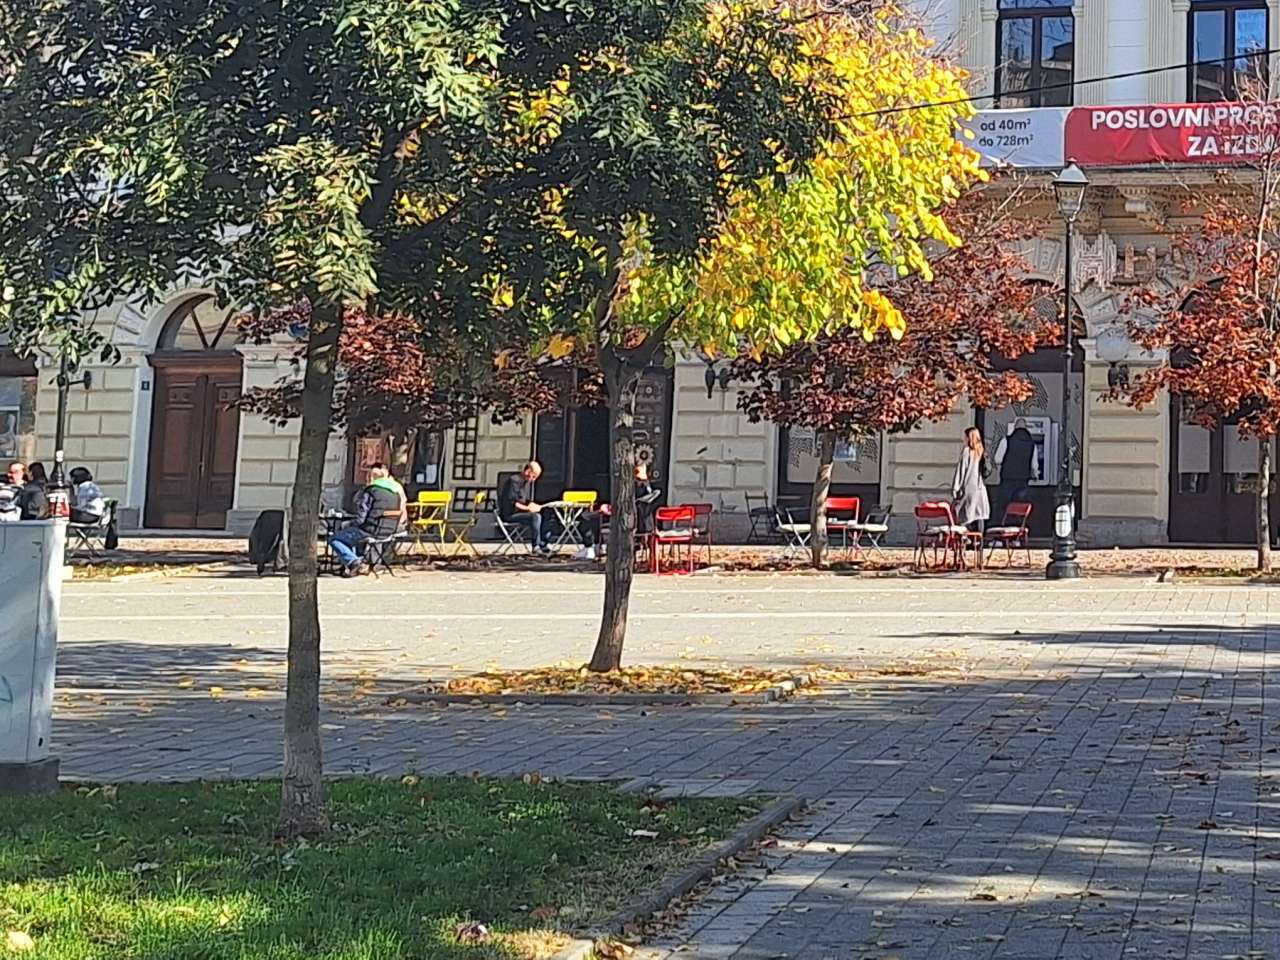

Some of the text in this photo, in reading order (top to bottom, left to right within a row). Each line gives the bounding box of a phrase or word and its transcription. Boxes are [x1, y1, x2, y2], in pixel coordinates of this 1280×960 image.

[980, 120, 996, 131] od
[1092, 106, 1210, 130] POSLOVNI
[979, 136, 994, 147] do
[1187, 136, 1219, 157] ZA
